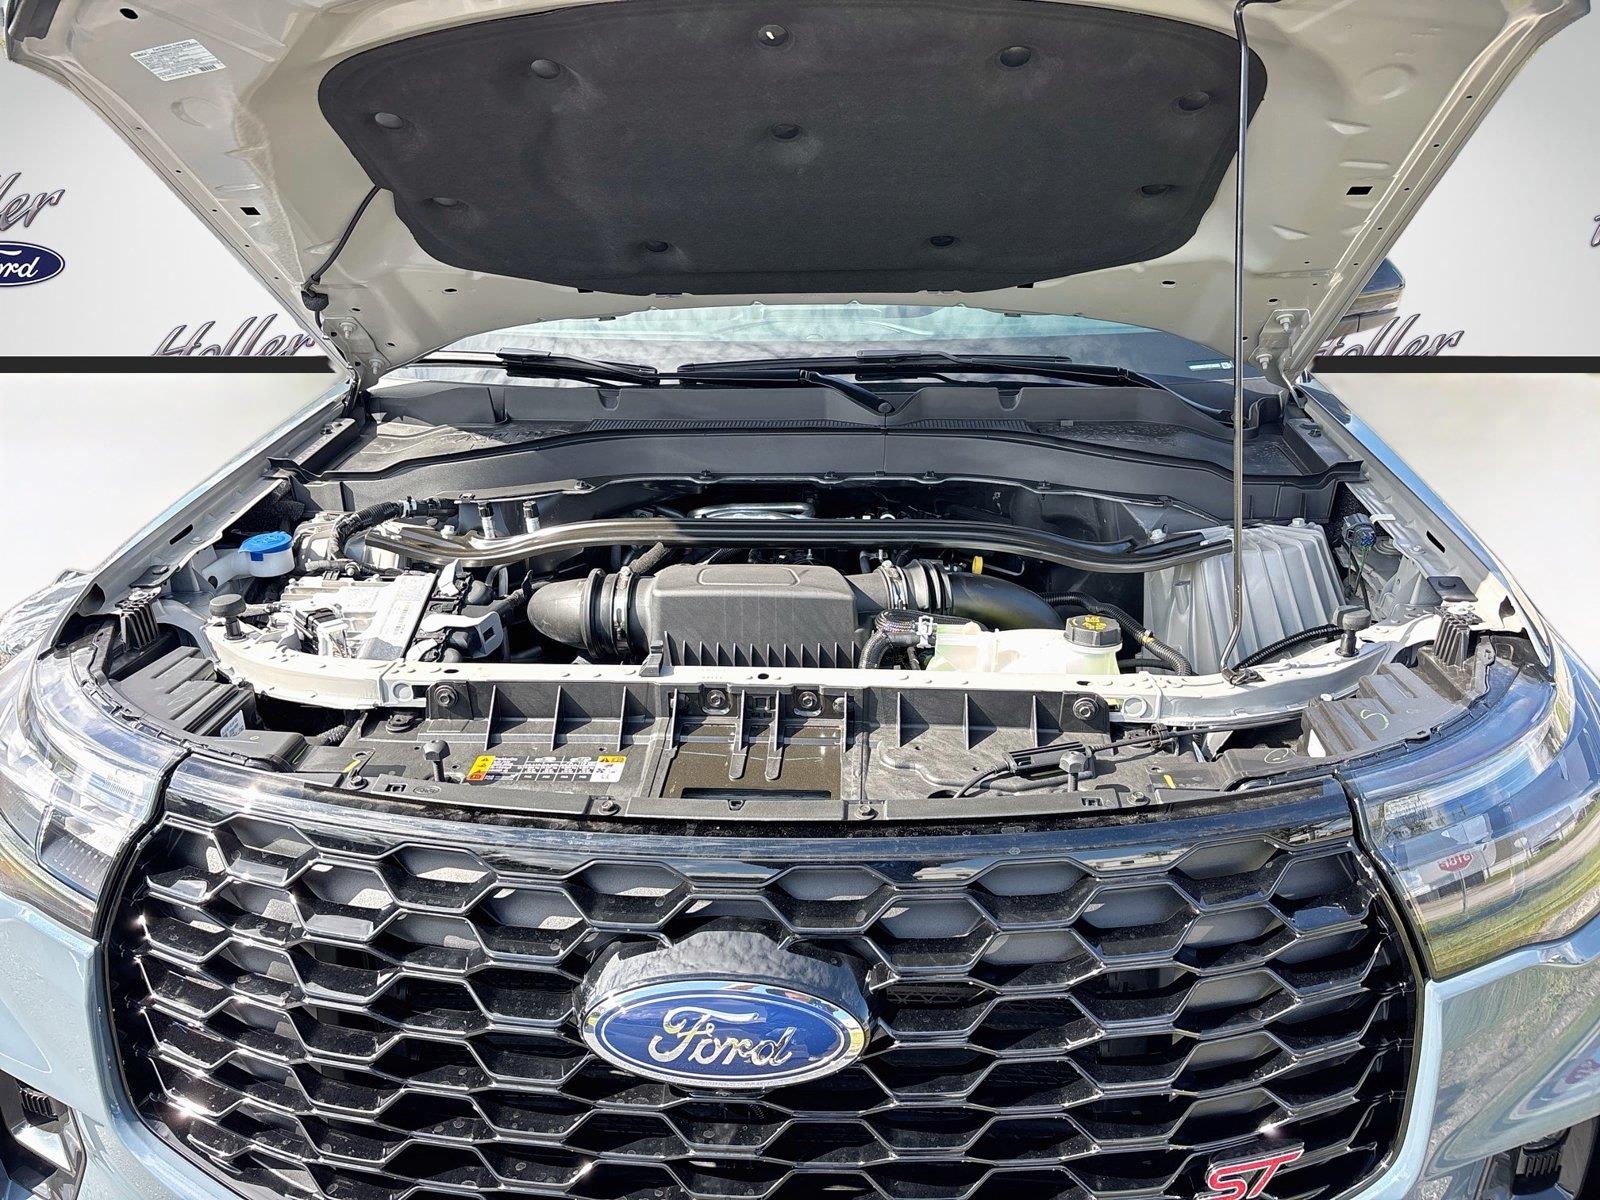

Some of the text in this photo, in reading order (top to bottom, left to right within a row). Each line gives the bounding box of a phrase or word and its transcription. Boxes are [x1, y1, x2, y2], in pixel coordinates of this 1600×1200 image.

[0, 172, 65, 231] er
[0, 250, 40, 278] rd
[1315, 313, 1465, 357] ller
[648, 1005, 797, 1067] Ford
[1202, 1149, 1305, 1200] ST
